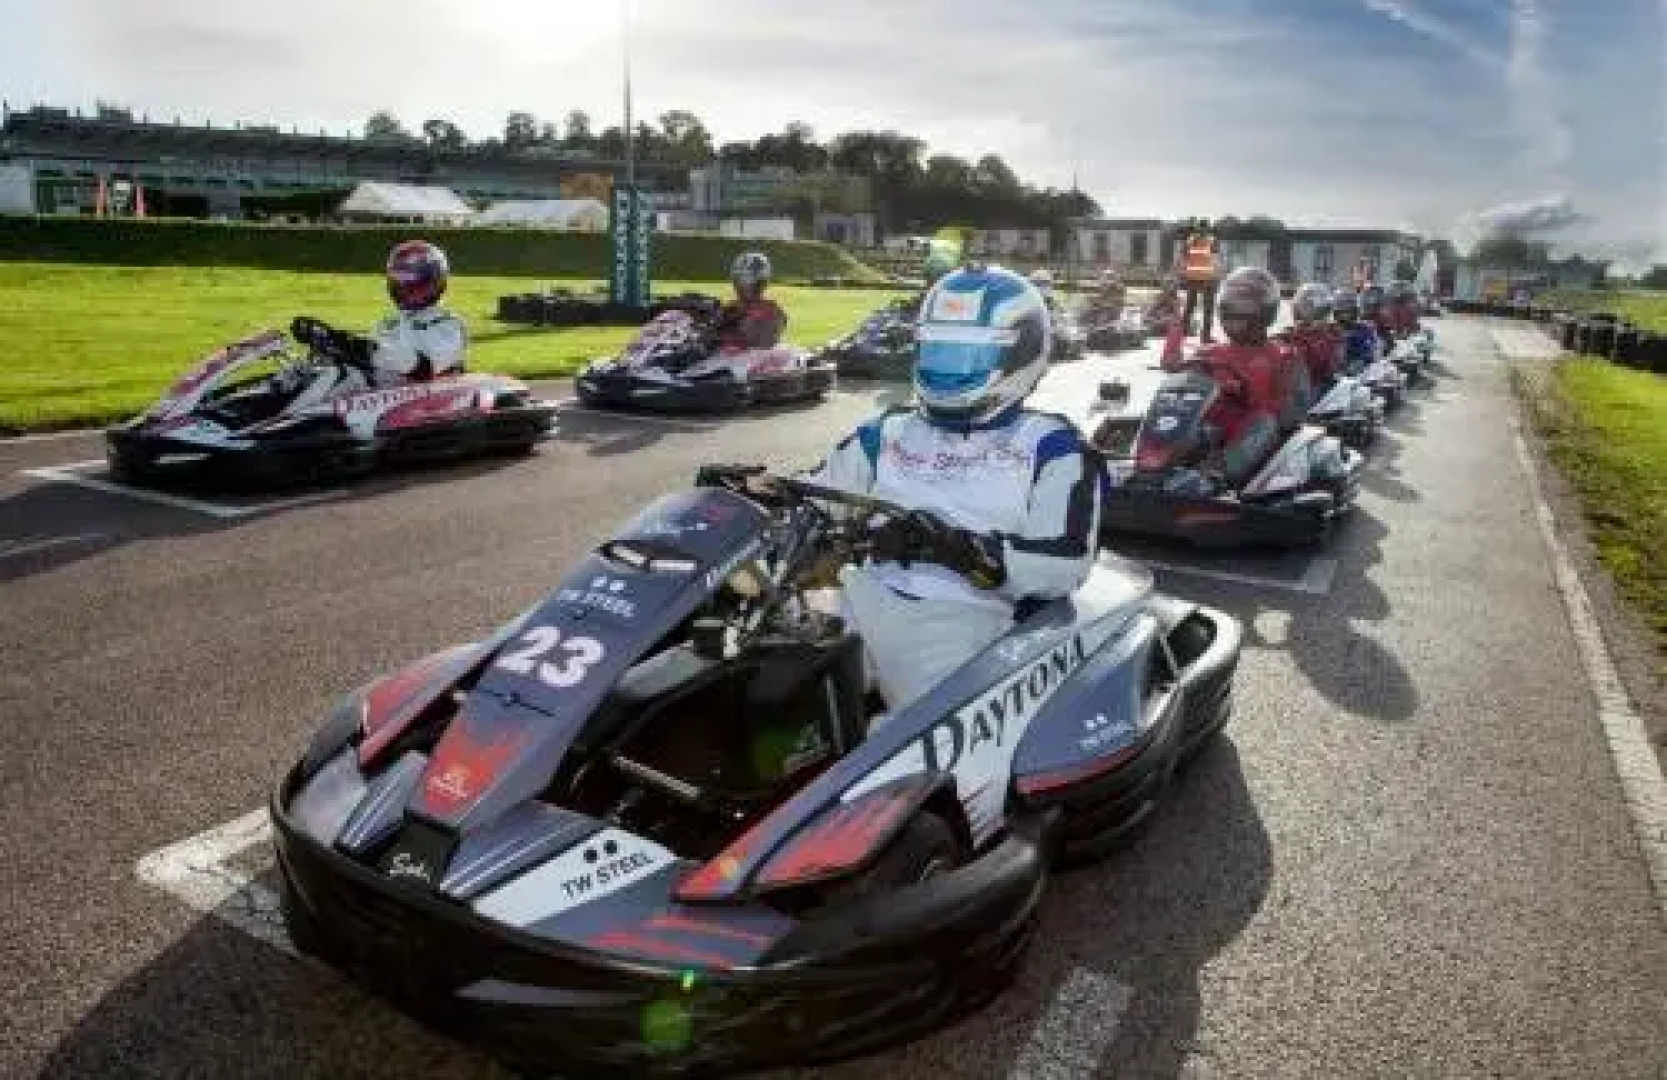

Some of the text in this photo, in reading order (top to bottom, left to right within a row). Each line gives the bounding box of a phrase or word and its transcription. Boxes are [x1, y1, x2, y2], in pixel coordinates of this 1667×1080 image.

[580, 592, 636, 617] STEEL
[494, 626, 604, 687] 23
[919, 632, 1090, 774] DAYTONA
[560, 851, 655, 899] TW STEEL
